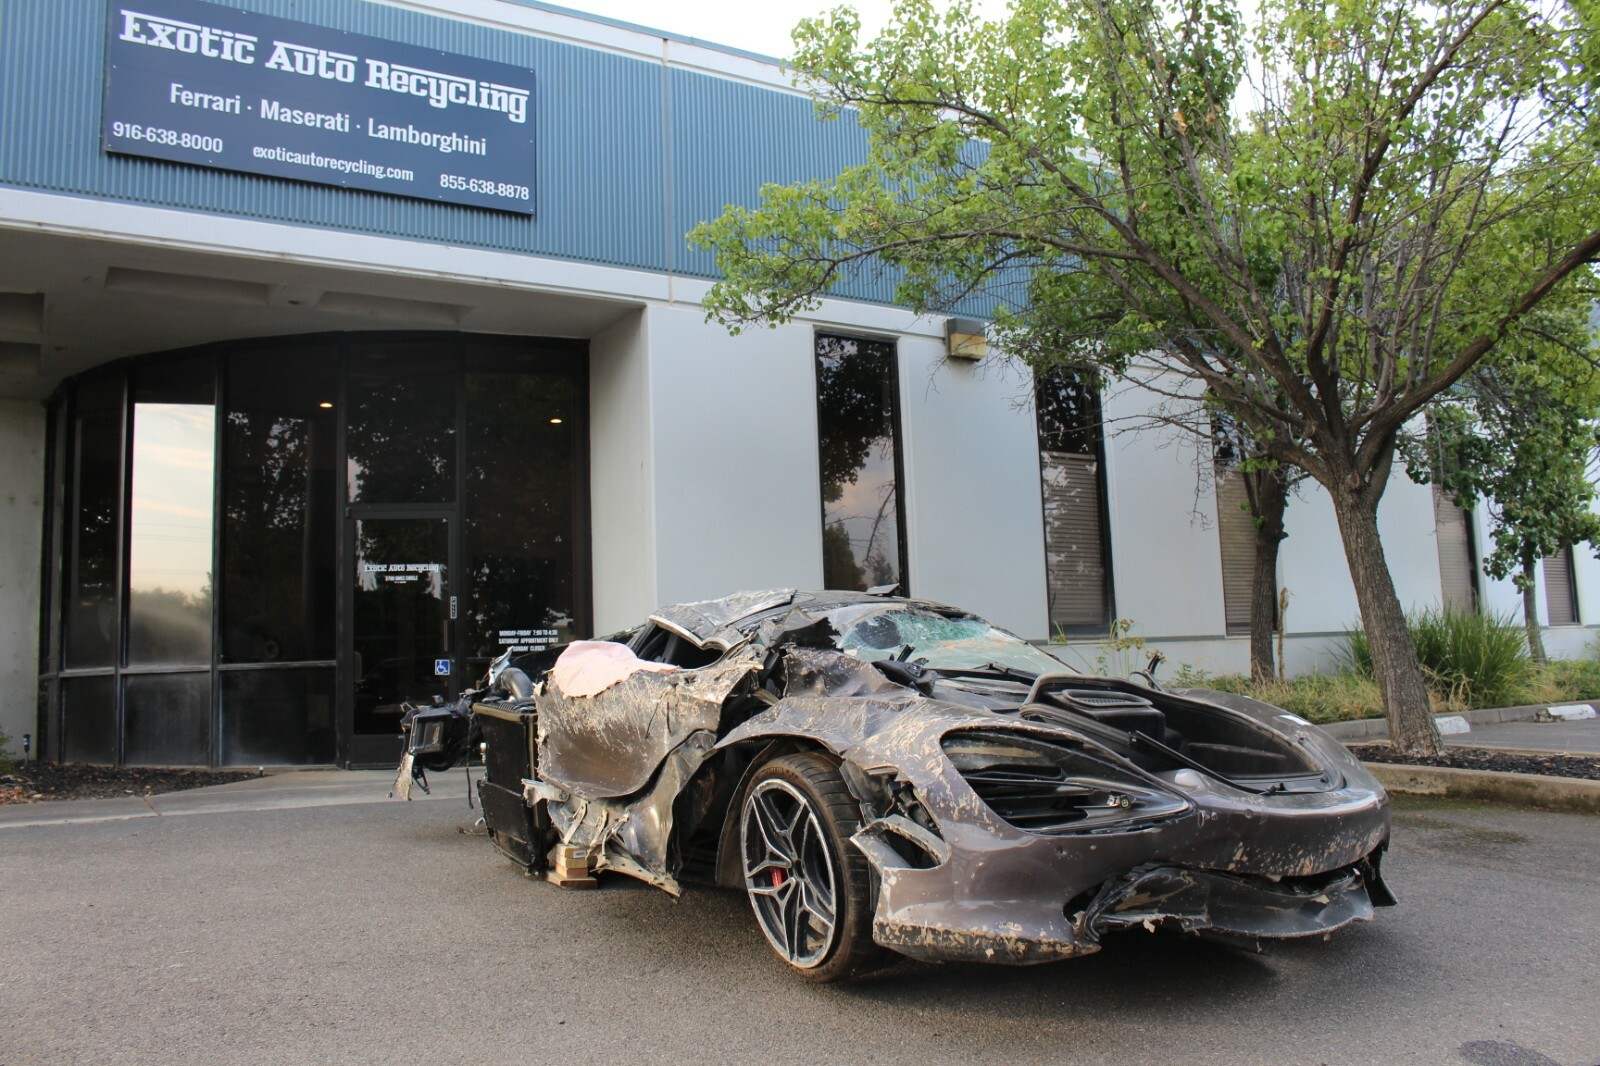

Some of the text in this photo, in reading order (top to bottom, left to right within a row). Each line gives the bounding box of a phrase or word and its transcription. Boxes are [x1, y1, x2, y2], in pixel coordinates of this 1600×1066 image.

[119, 9, 530, 124] Exotic Auto Recycling
[112, 121, 223, 154] 916-638-8000
[170, 83, 487, 156] Ferrari Maserati Lamborghini
[252, 144, 414, 182] exoticautorecycling.com
[440, 174, 530, 201] 855-638-8878
